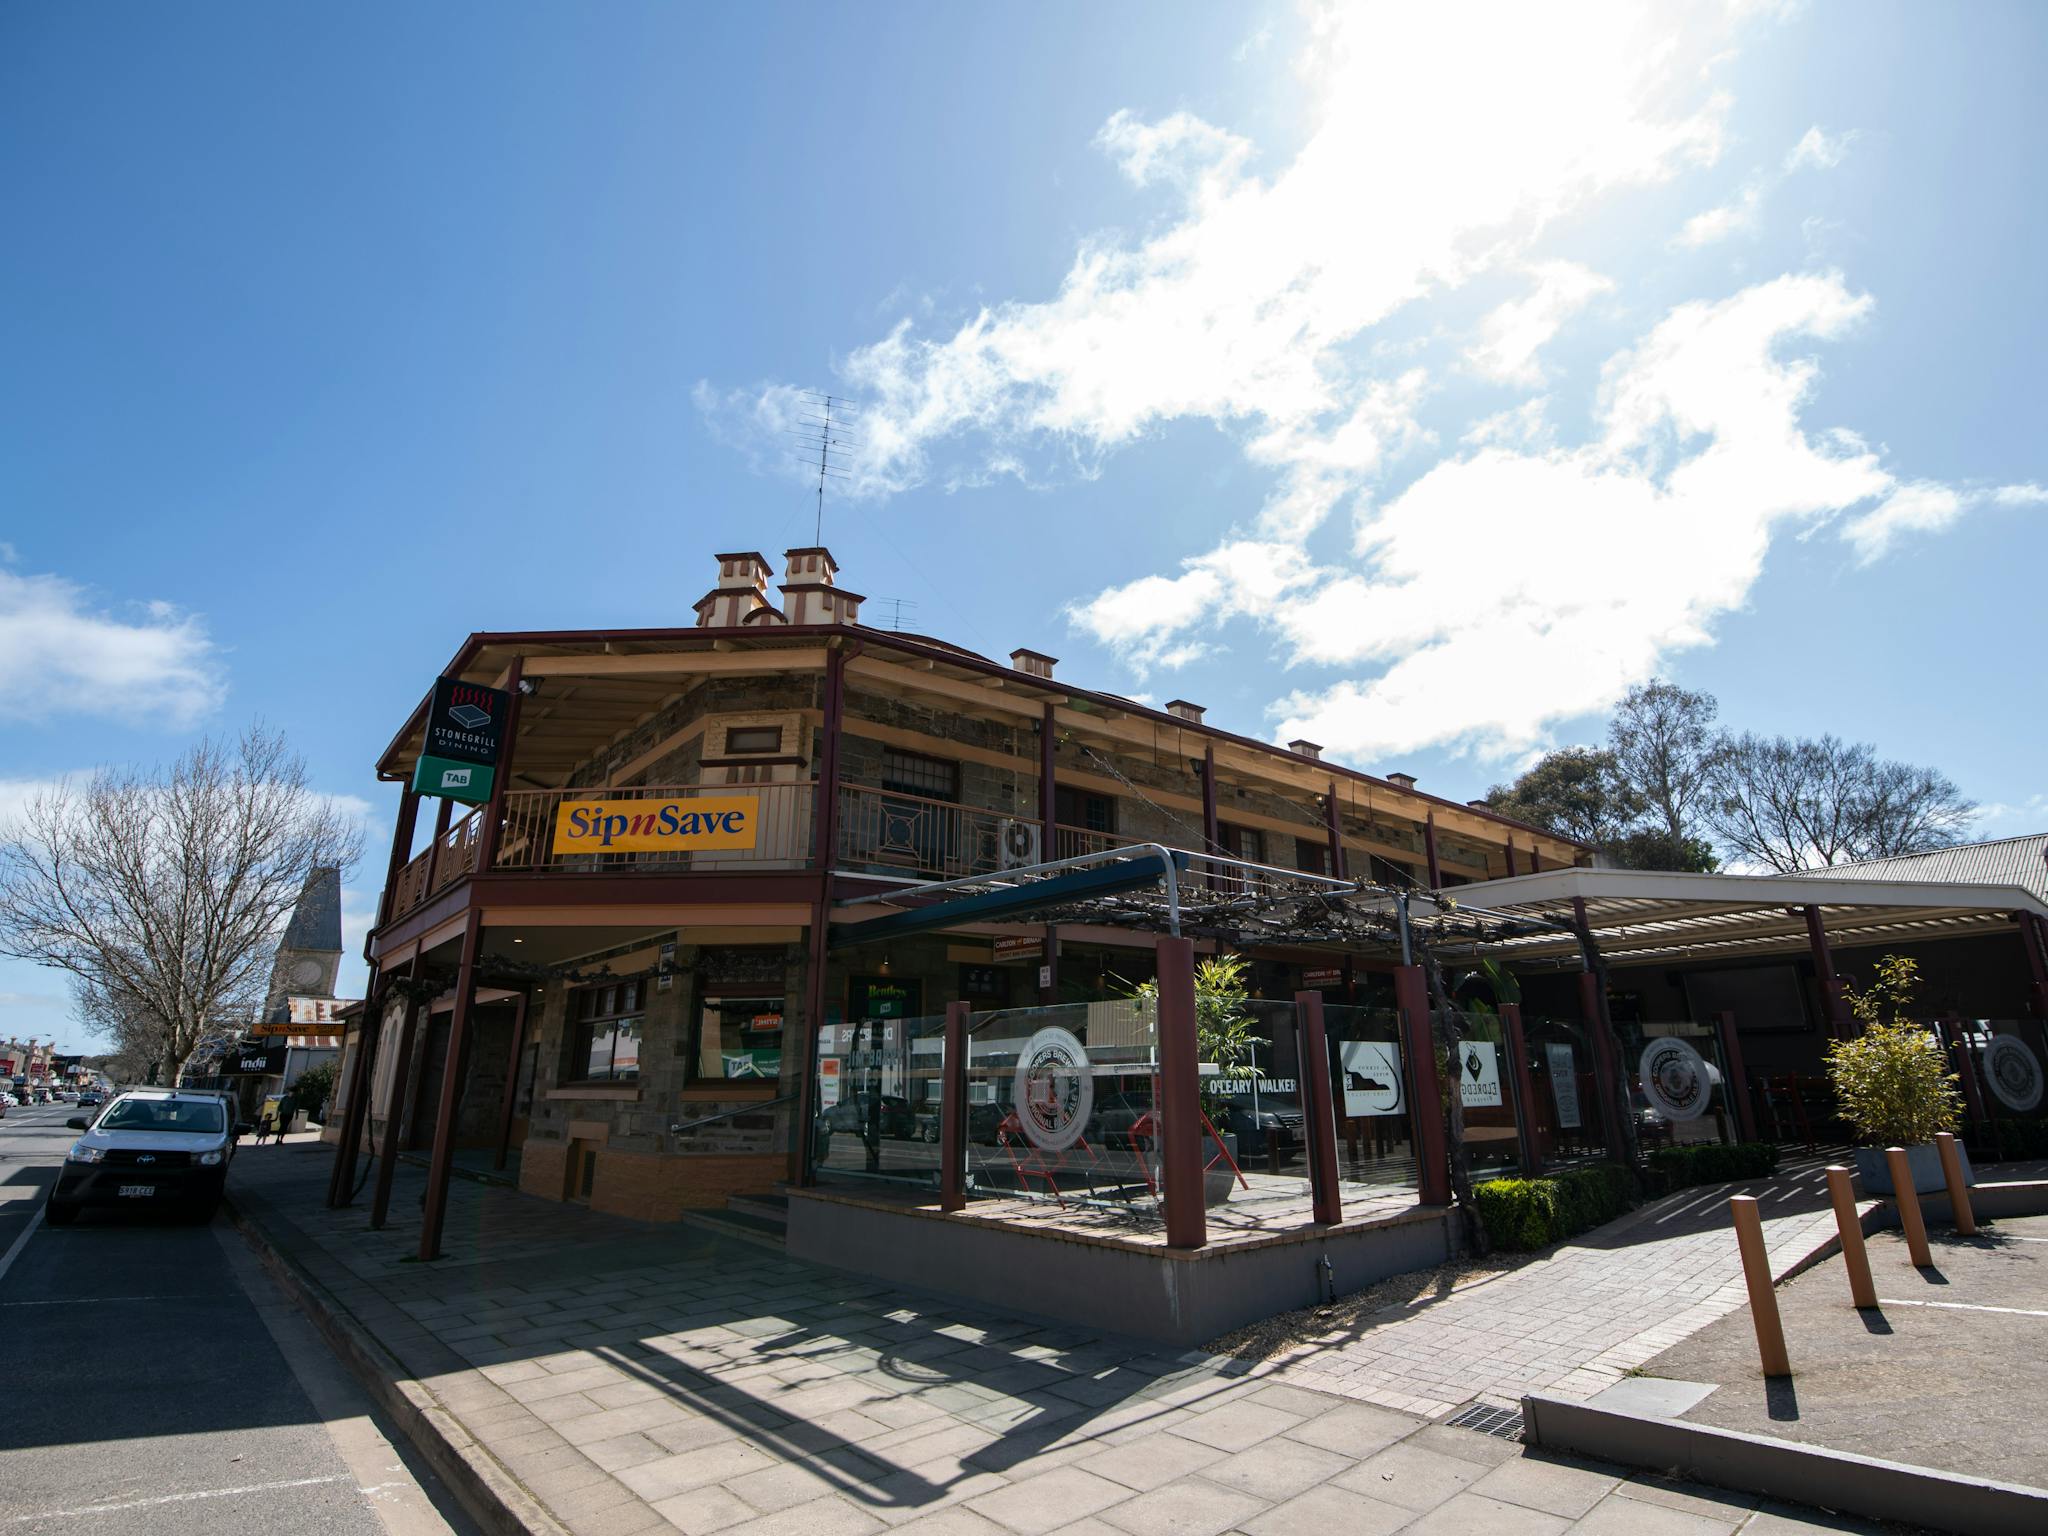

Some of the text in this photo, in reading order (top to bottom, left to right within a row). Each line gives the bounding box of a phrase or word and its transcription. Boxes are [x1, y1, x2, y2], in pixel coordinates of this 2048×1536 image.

[434, 727, 496, 748] STONEGRILL
[438, 739, 489, 754] DINING
[446, 773, 468, 784] TAB
[567, 805, 745, 846] SipnSave
[995, 940, 1017, 949] CARLTON
[240, 1056, 267, 1069] indii
[1209, 1078, 1297, 1094] O'LEARY WALKER
